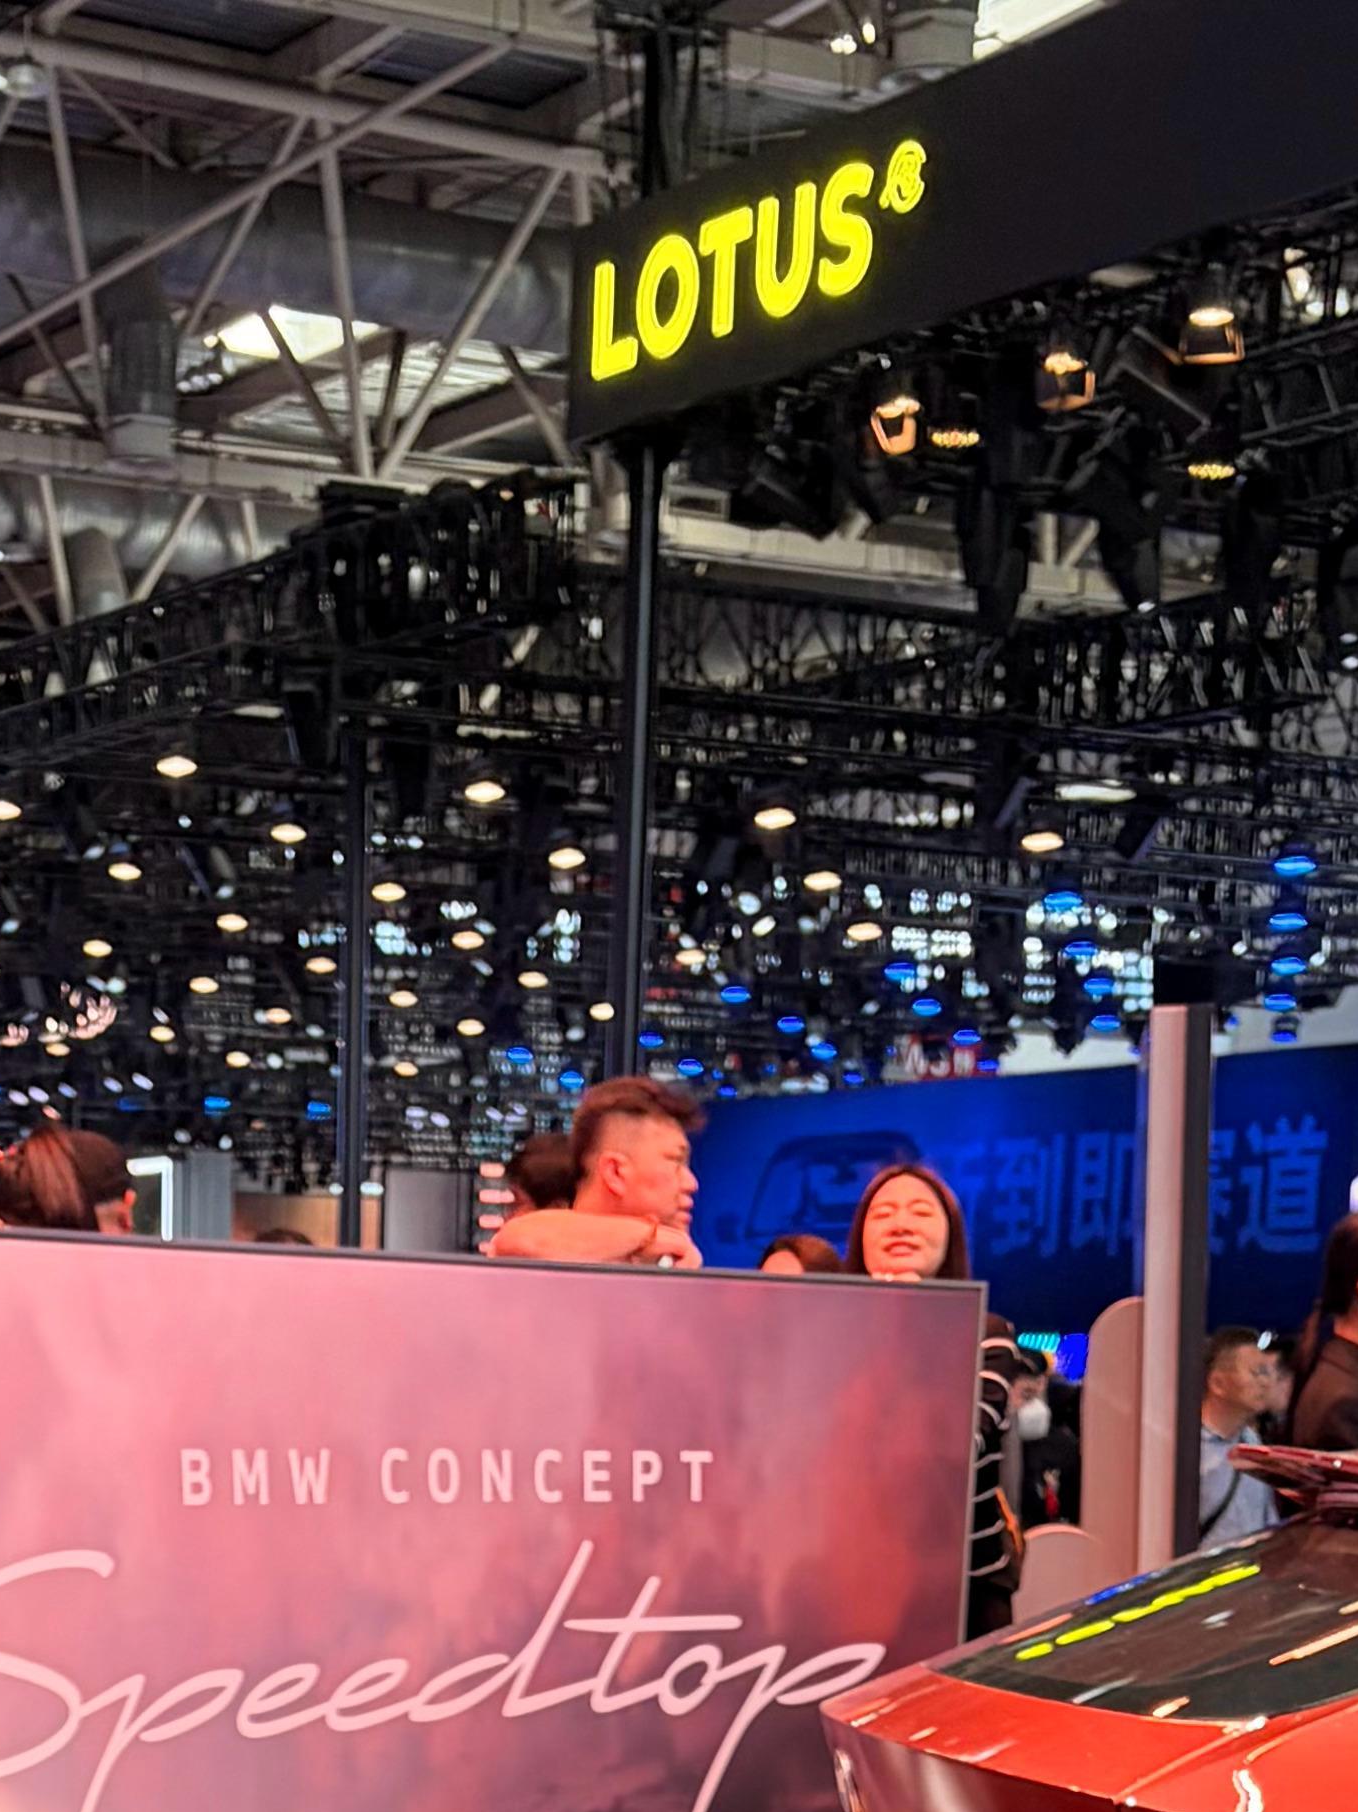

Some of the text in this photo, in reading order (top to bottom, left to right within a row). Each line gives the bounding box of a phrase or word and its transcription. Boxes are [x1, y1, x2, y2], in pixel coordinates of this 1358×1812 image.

[592, 162, 874, 381] LOTUS
[181, 1447, 715, 1505] BMW CONCEPT
